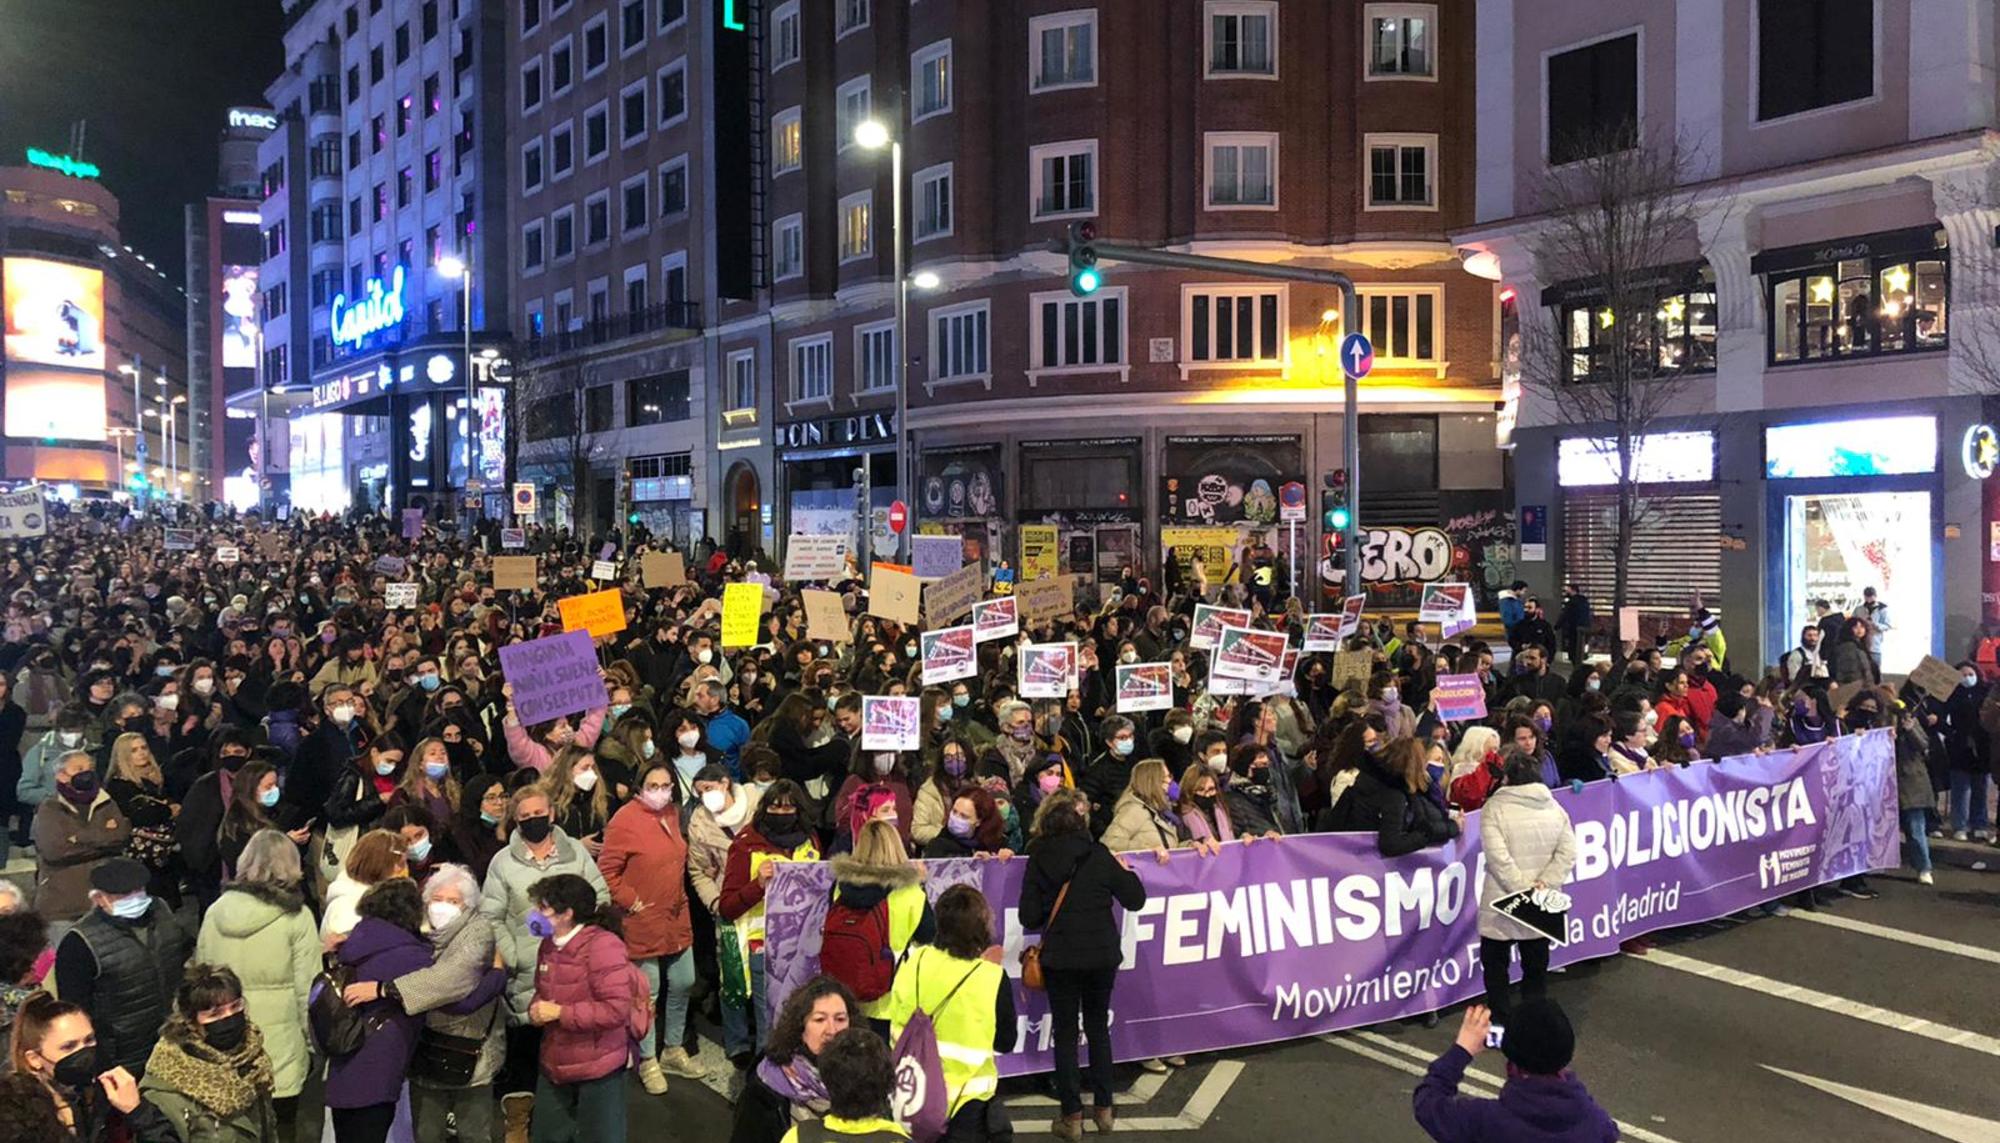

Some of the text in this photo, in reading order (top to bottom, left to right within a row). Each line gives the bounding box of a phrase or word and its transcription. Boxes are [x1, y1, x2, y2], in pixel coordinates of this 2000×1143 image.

[229, 110, 277, 130] fnac
[331, 265, 404, 349] Capitol
[507, 639, 576, 671] NINGUNA
[1119, 861, 1467, 971] FEMINISMO
[1561, 776, 1817, 885] BOLICIONISTA
[1271, 955, 1461, 1021] Movimiento
